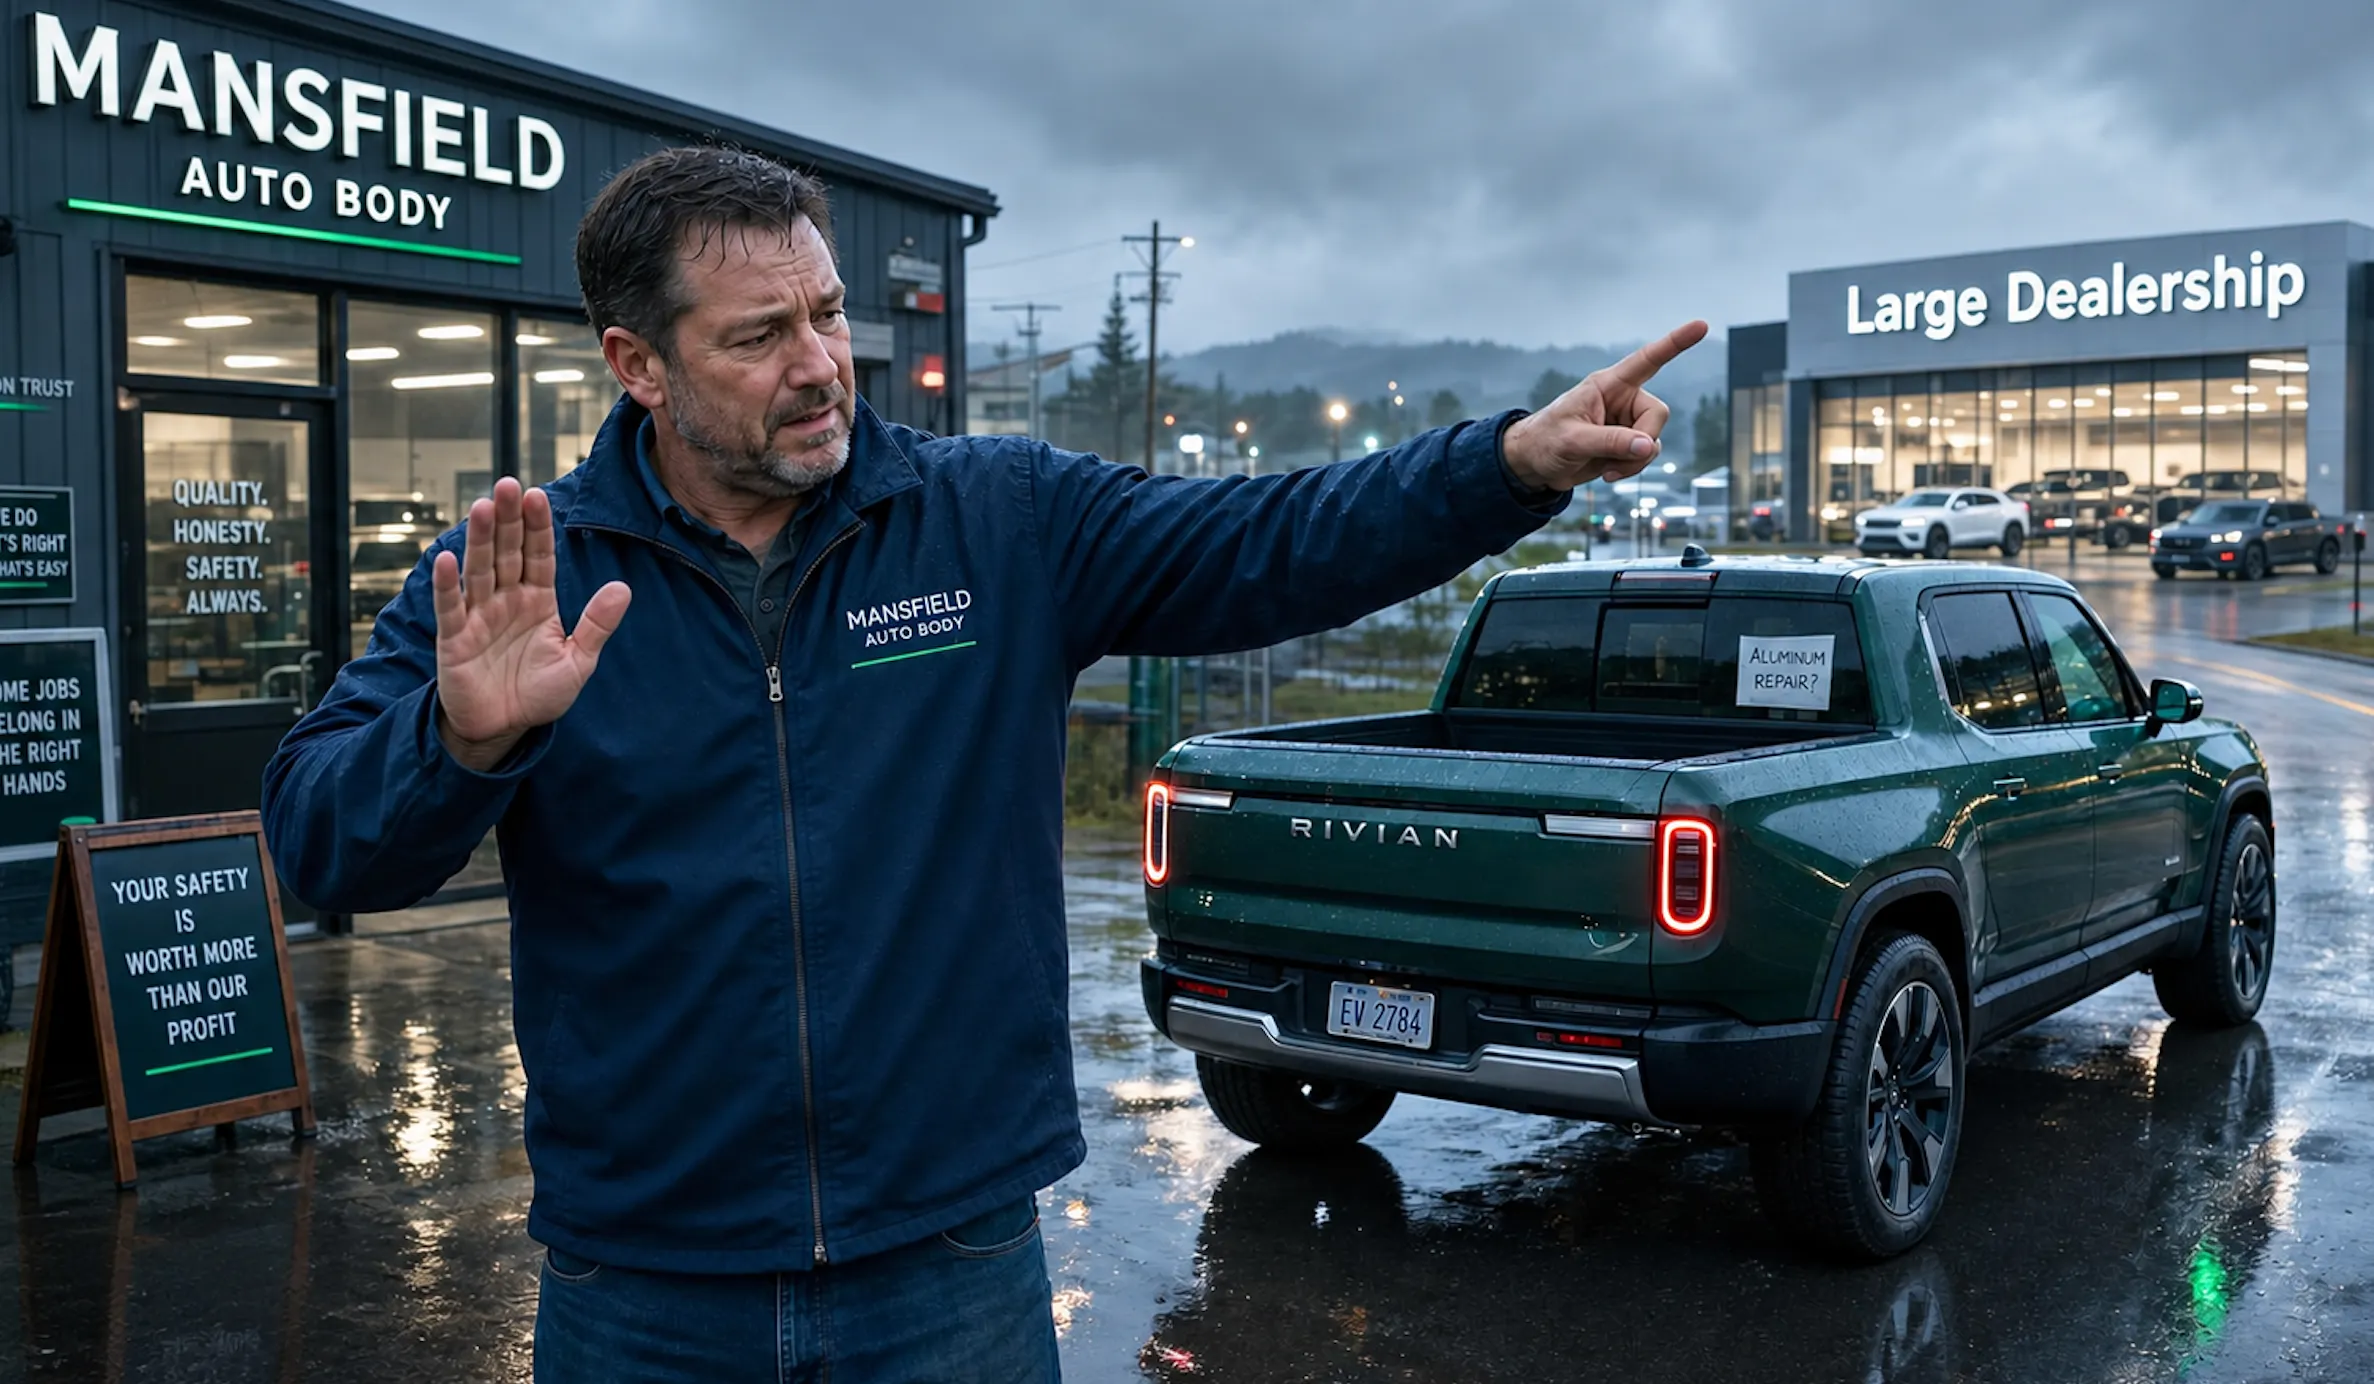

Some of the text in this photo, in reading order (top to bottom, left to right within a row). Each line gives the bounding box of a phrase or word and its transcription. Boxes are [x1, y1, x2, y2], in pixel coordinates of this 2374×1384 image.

[34, 11, 566, 191] MANSFIELD
[181, 156, 452, 229] AUTO BODY
[1848, 250, 2305, 340] Large Dealership
[0, 377, 74, 397] N TRUST
[174, 479, 268, 507] QUALITY.
[15, 507, 38, 527] DO
[22, 533, 67, 552] RIGHT
[174, 519, 271, 544] HONESTY.
[37, 560, 68, 576] EASY
[186, 555, 263, 580] SAFETY.
[186, 590, 268, 614] ALWAYS.
[846, 589, 971, 630] MANSFIELD
[865, 614, 964, 647] AUTO BODY
[1749, 647, 1825, 665] ALUMINUM
[0, 677, 80, 702] ME JOBS
[1755, 674, 1818, 693] REPAIR?
[62, 708, 81, 731] IN
[28, 738, 81, 763] RIGHT
[3, 770, 67, 795] HANDS
[1291, 817, 1458, 848] RIVIAN
[111, 867, 249, 904] YOUR SAFETY
[174, 909, 195, 933] IS
[125, 936, 257, 976] WORTH MORE
[147, 974, 248, 1010] THAN OUR
[167, 1011, 237, 1045] PROFIT
[1341, 998, 1421, 1036] EV 2784
